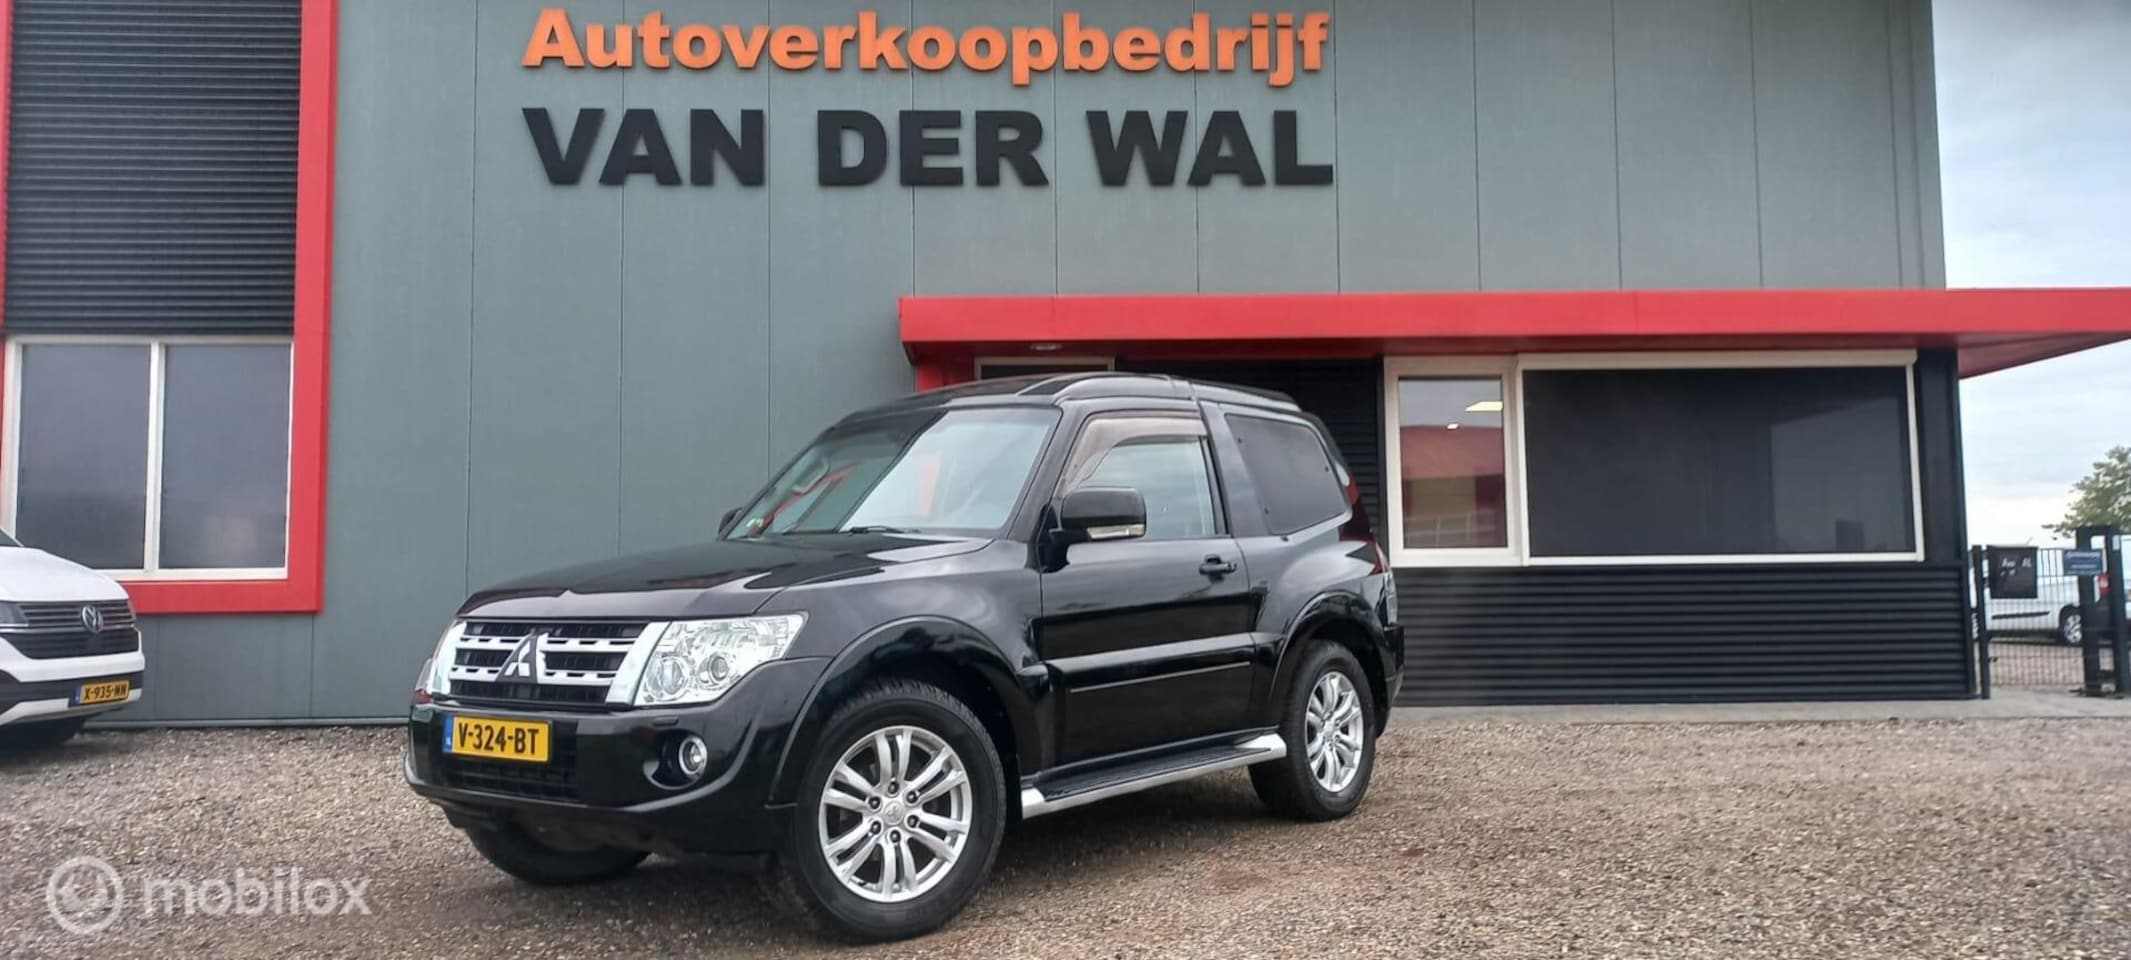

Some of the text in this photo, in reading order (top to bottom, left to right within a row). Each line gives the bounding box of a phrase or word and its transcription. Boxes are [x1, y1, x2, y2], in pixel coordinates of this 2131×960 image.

[521, 7, 1331, 88] Autoverkoopbedrijf
[521, 107, 1334, 188] VAN DER WAL
[458, 722, 540, 756] V-324-BT
